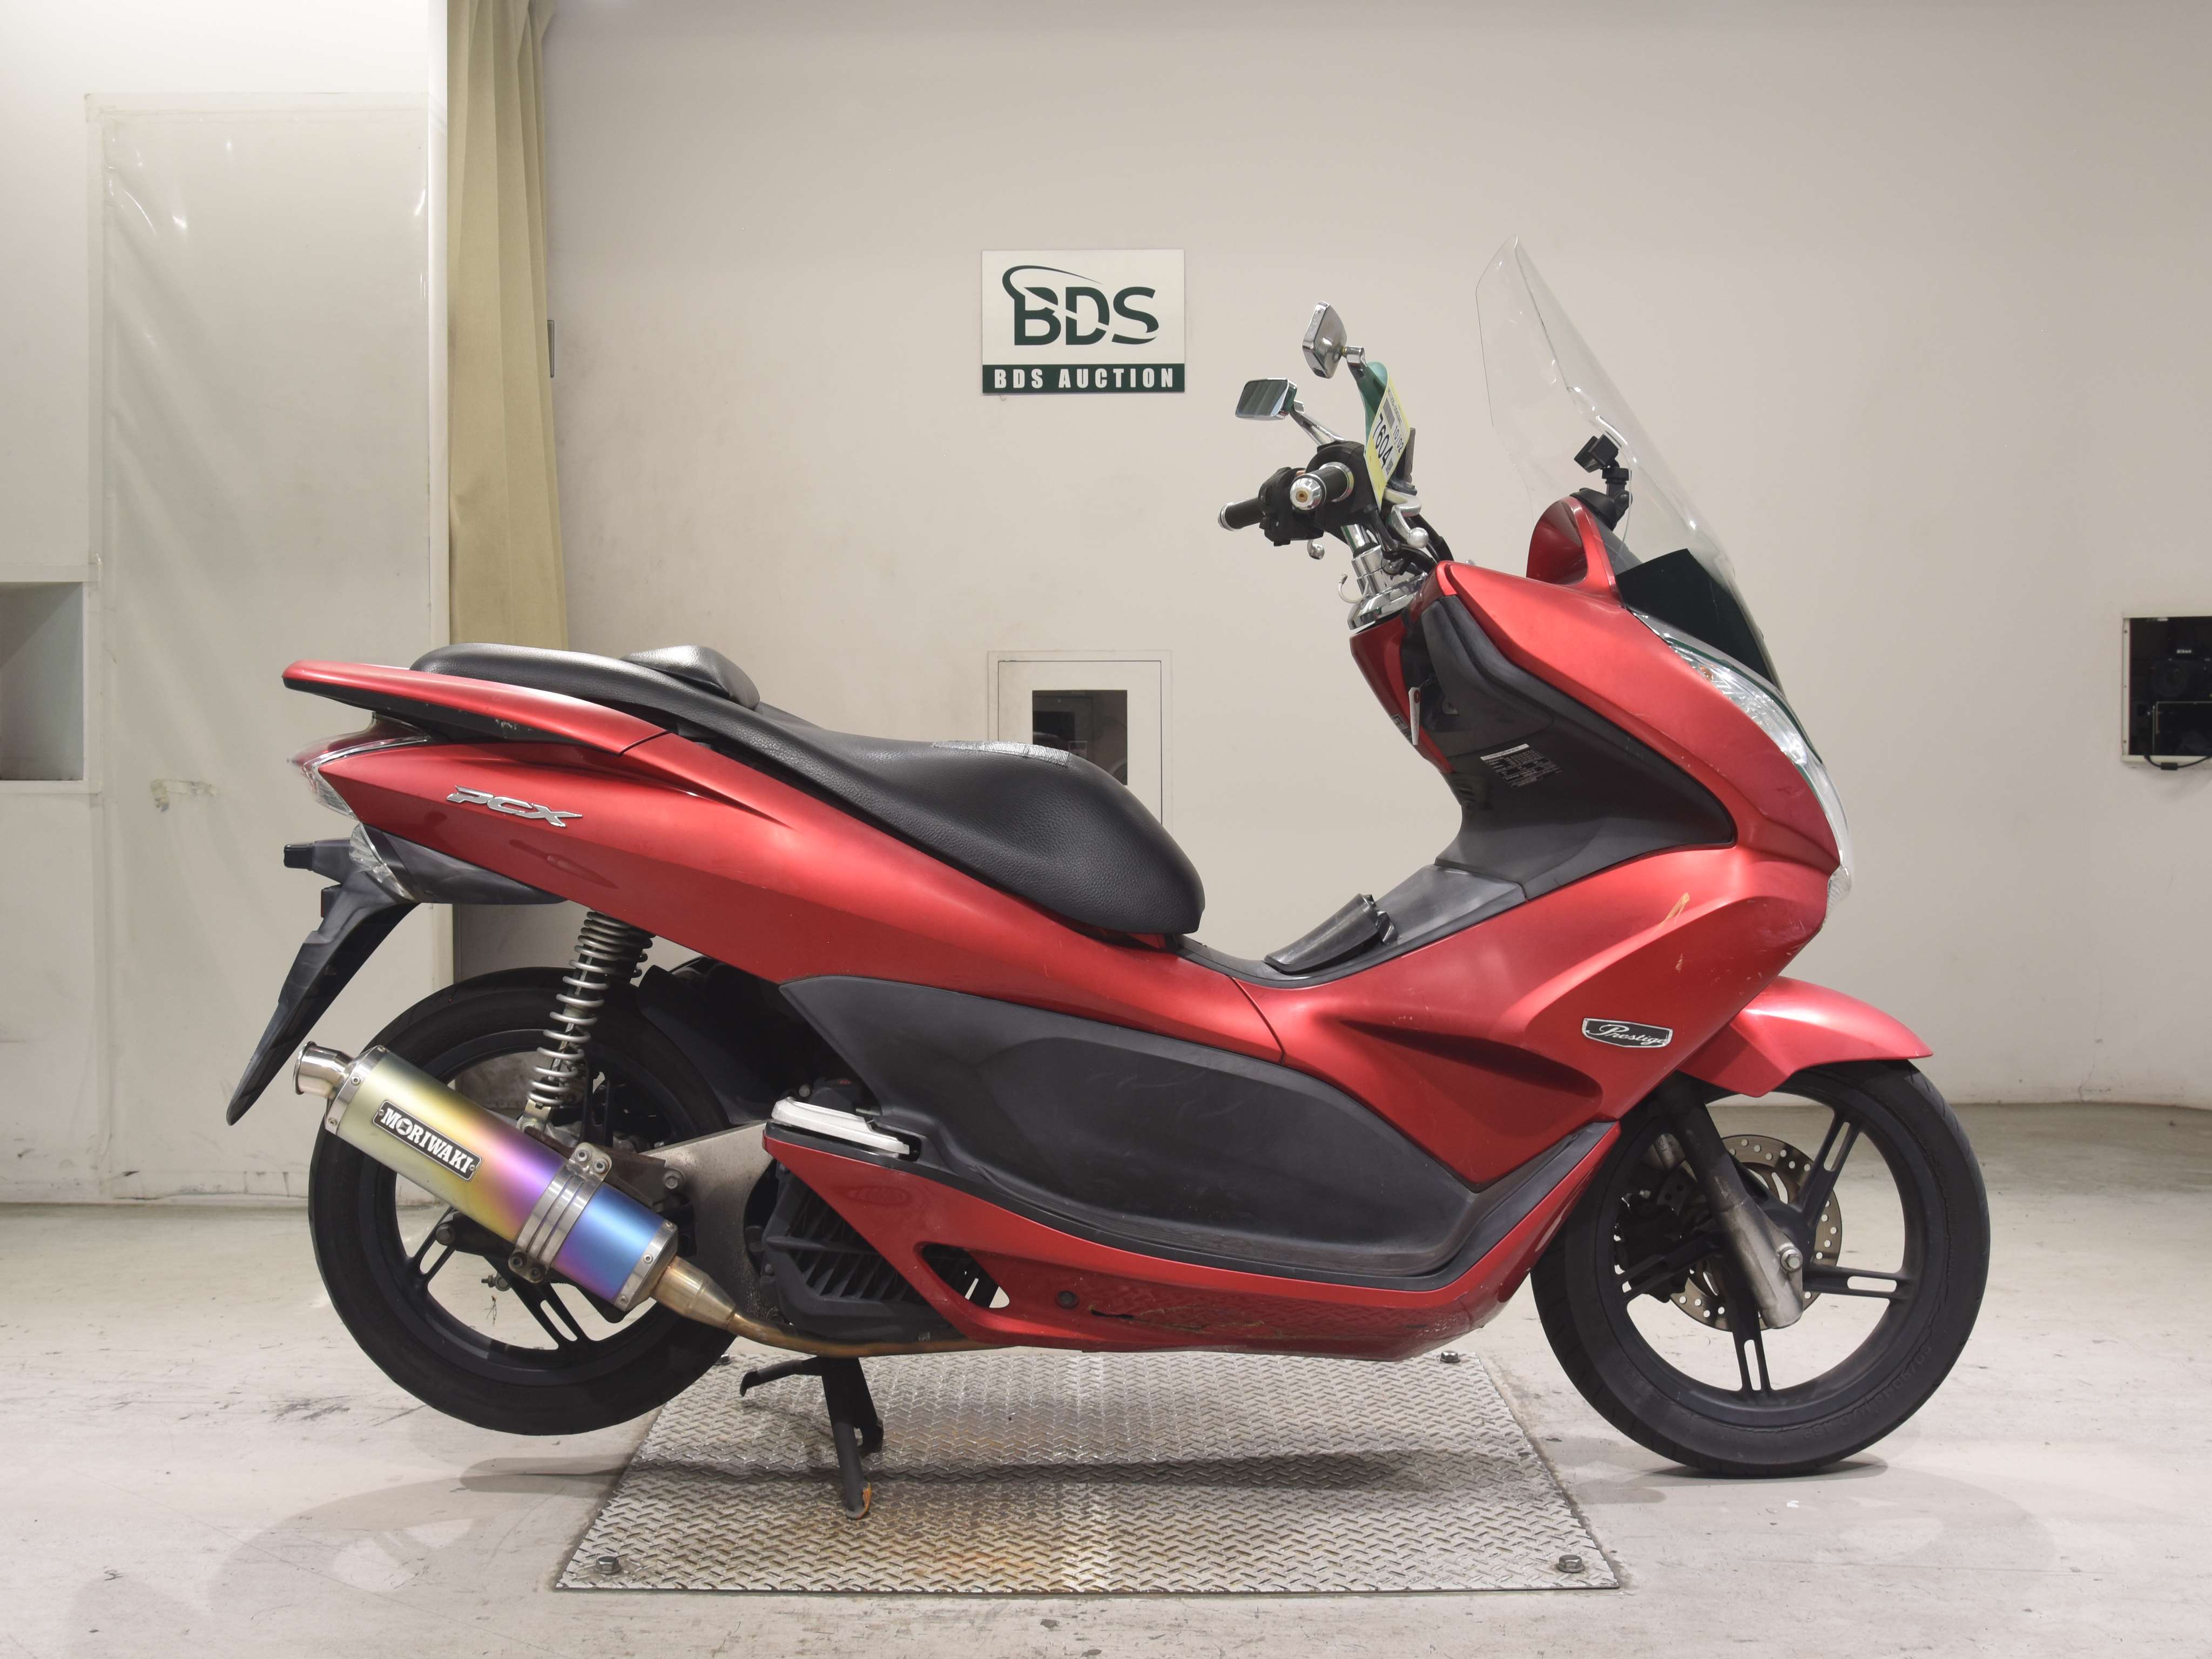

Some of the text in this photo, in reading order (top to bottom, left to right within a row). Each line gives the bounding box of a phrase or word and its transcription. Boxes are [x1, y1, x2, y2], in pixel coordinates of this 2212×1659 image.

[1002, 265, 1159, 346] BDS
[994, 367, 1174, 389] BDS AUCTION
[1372, 413, 1394, 469] 7604
[446, 785, 583, 827] PCX
[1586, 1024, 1670, 1045] Prestige
[380, 1107, 474, 1174] MORIWAKI
